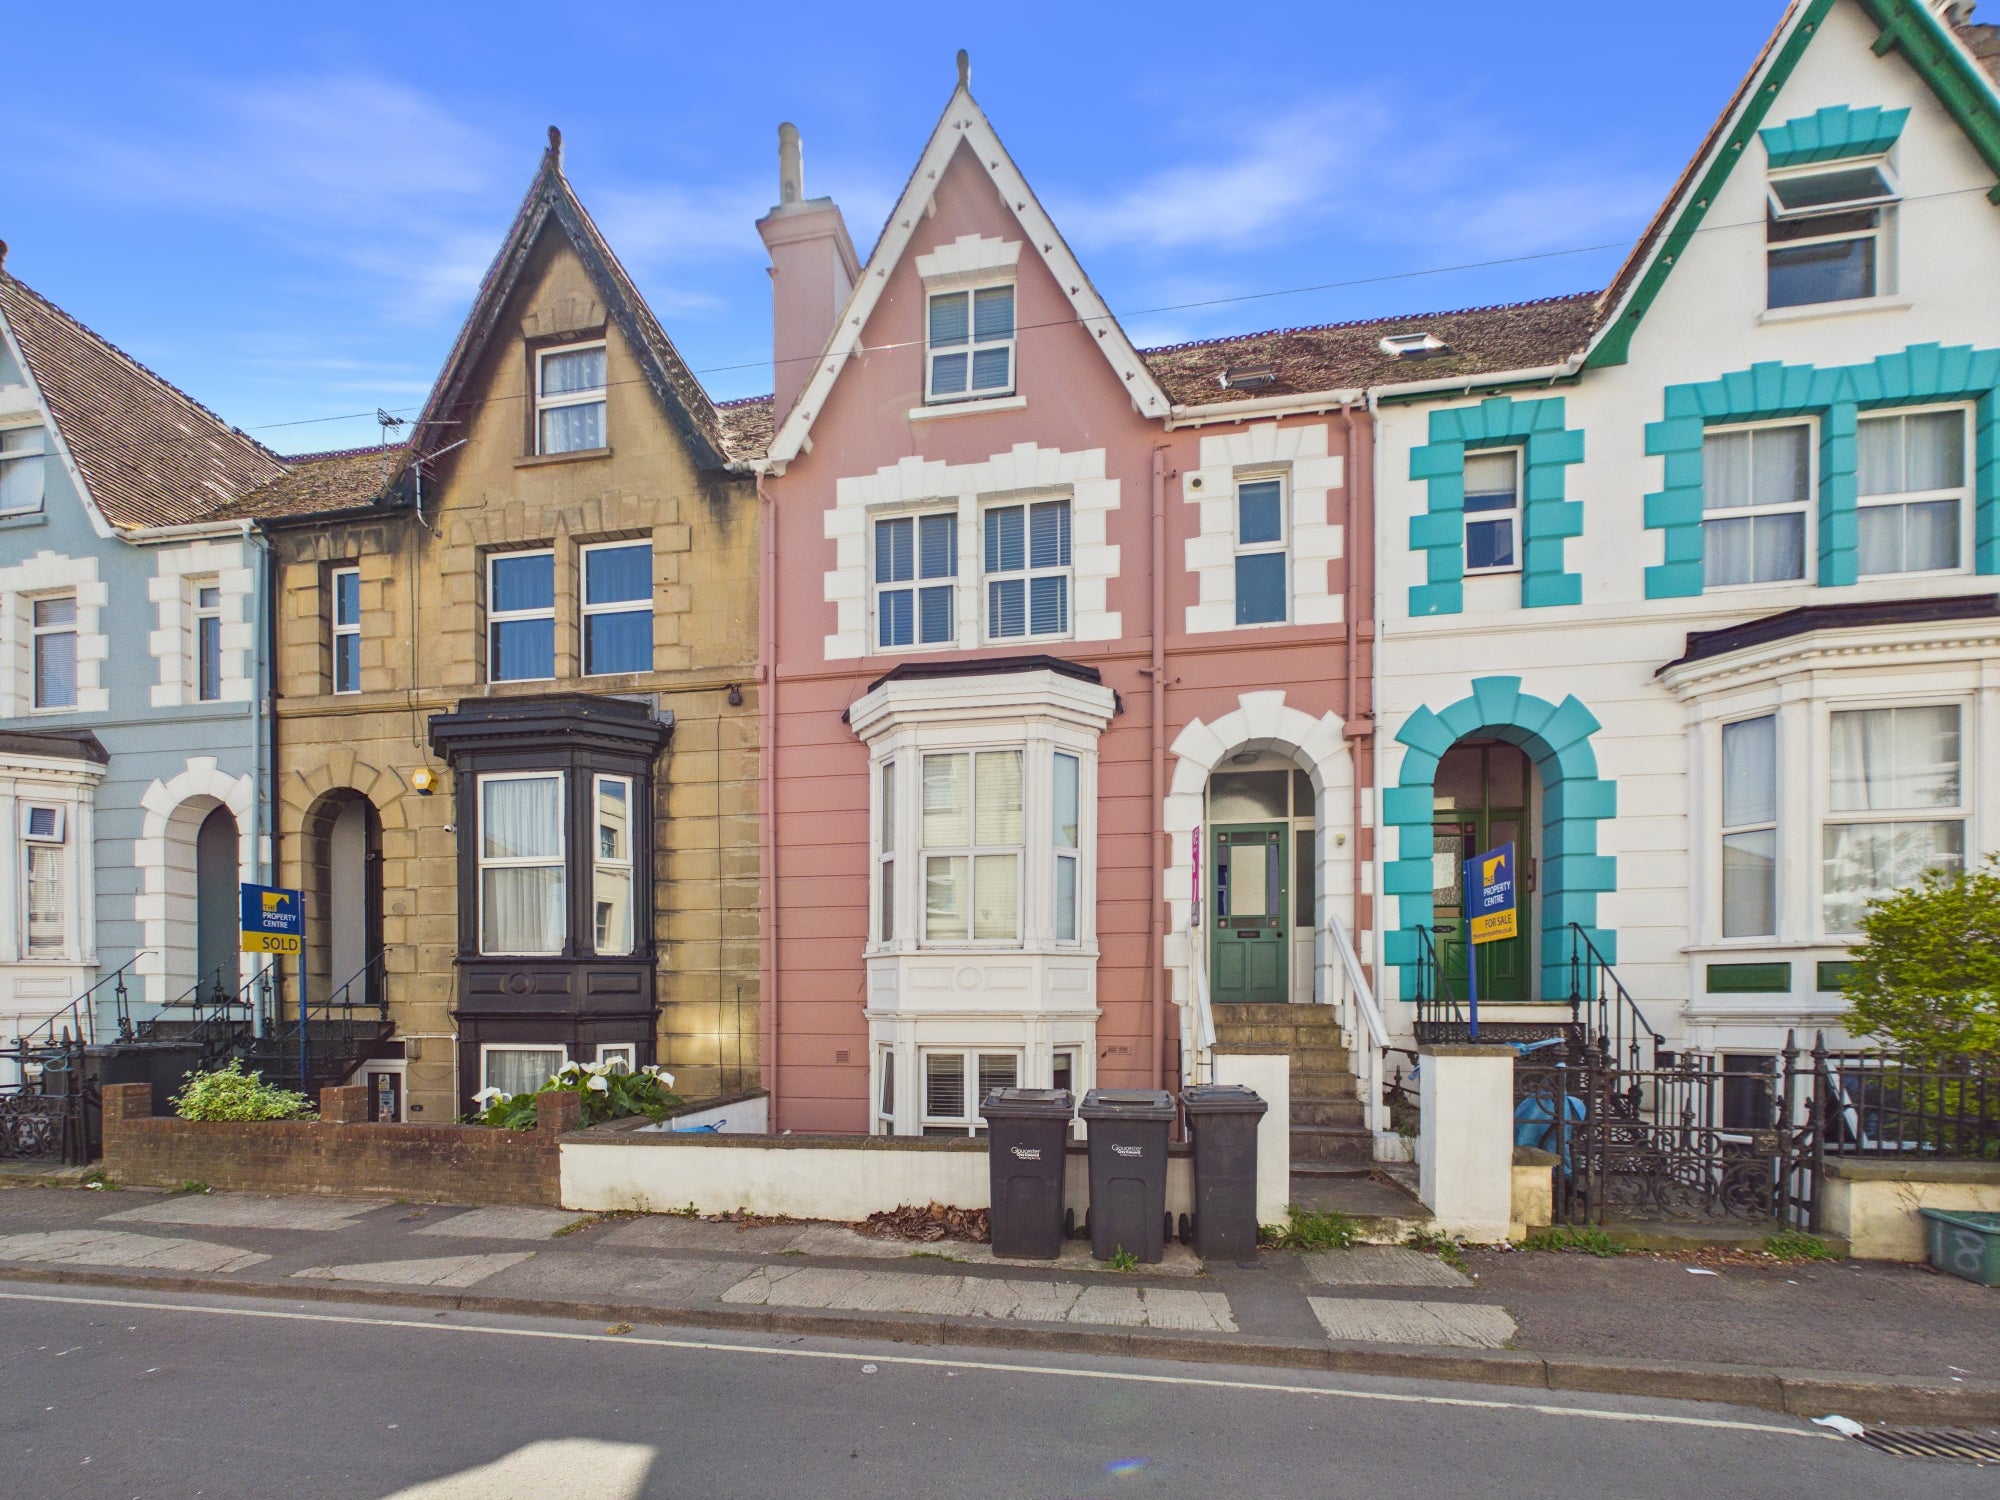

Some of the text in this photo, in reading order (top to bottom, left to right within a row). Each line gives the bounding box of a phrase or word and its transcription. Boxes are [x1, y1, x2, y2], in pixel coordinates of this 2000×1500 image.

[1483, 881, 1511, 897] PROPERTY
[1484, 894, 1504, 907] CENTRE
[263, 904, 277, 912] THE
[262, 912, 296, 921] PROPERTY
[1485, 914, 1512, 928] FOR SALE
[263, 920, 288, 929] CENTRE
[262, 937, 298, 951] SOLD
[1010, 1146, 1041, 1154] Gloucester
[1111, 1143, 1143, 1151] Gloucester
[1936, 1221, 1986, 1272] 18
